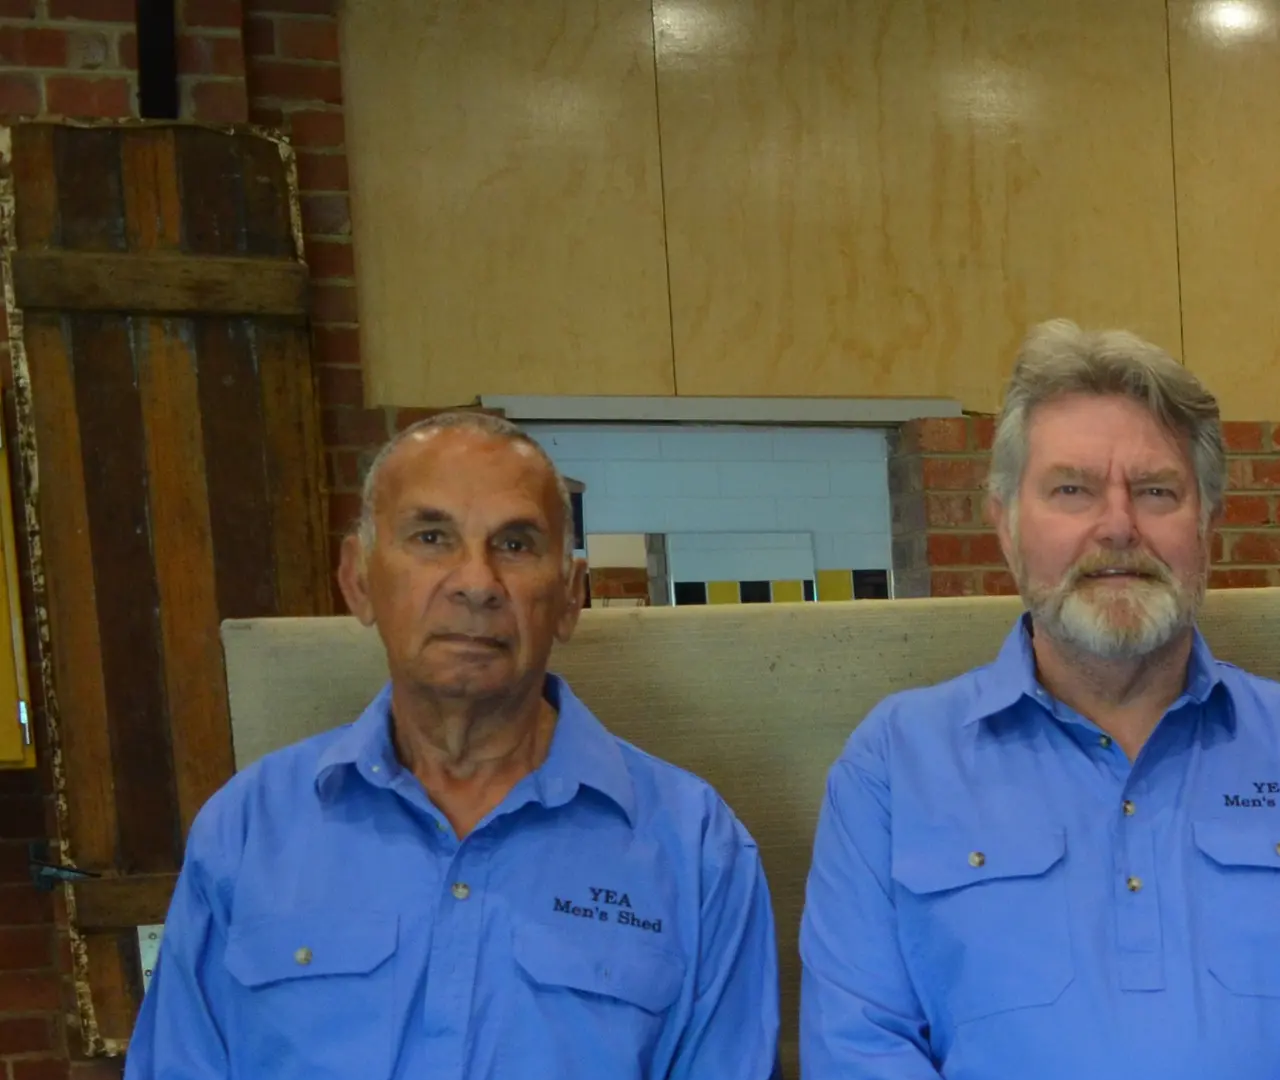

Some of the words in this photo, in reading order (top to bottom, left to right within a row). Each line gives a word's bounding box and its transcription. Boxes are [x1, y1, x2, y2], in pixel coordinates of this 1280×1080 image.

[1223, 794, 1277, 808] Men's
[588, 886, 632, 909] YEA
[553, 896, 609, 922] Men's
[617, 909, 662, 933] Shed
